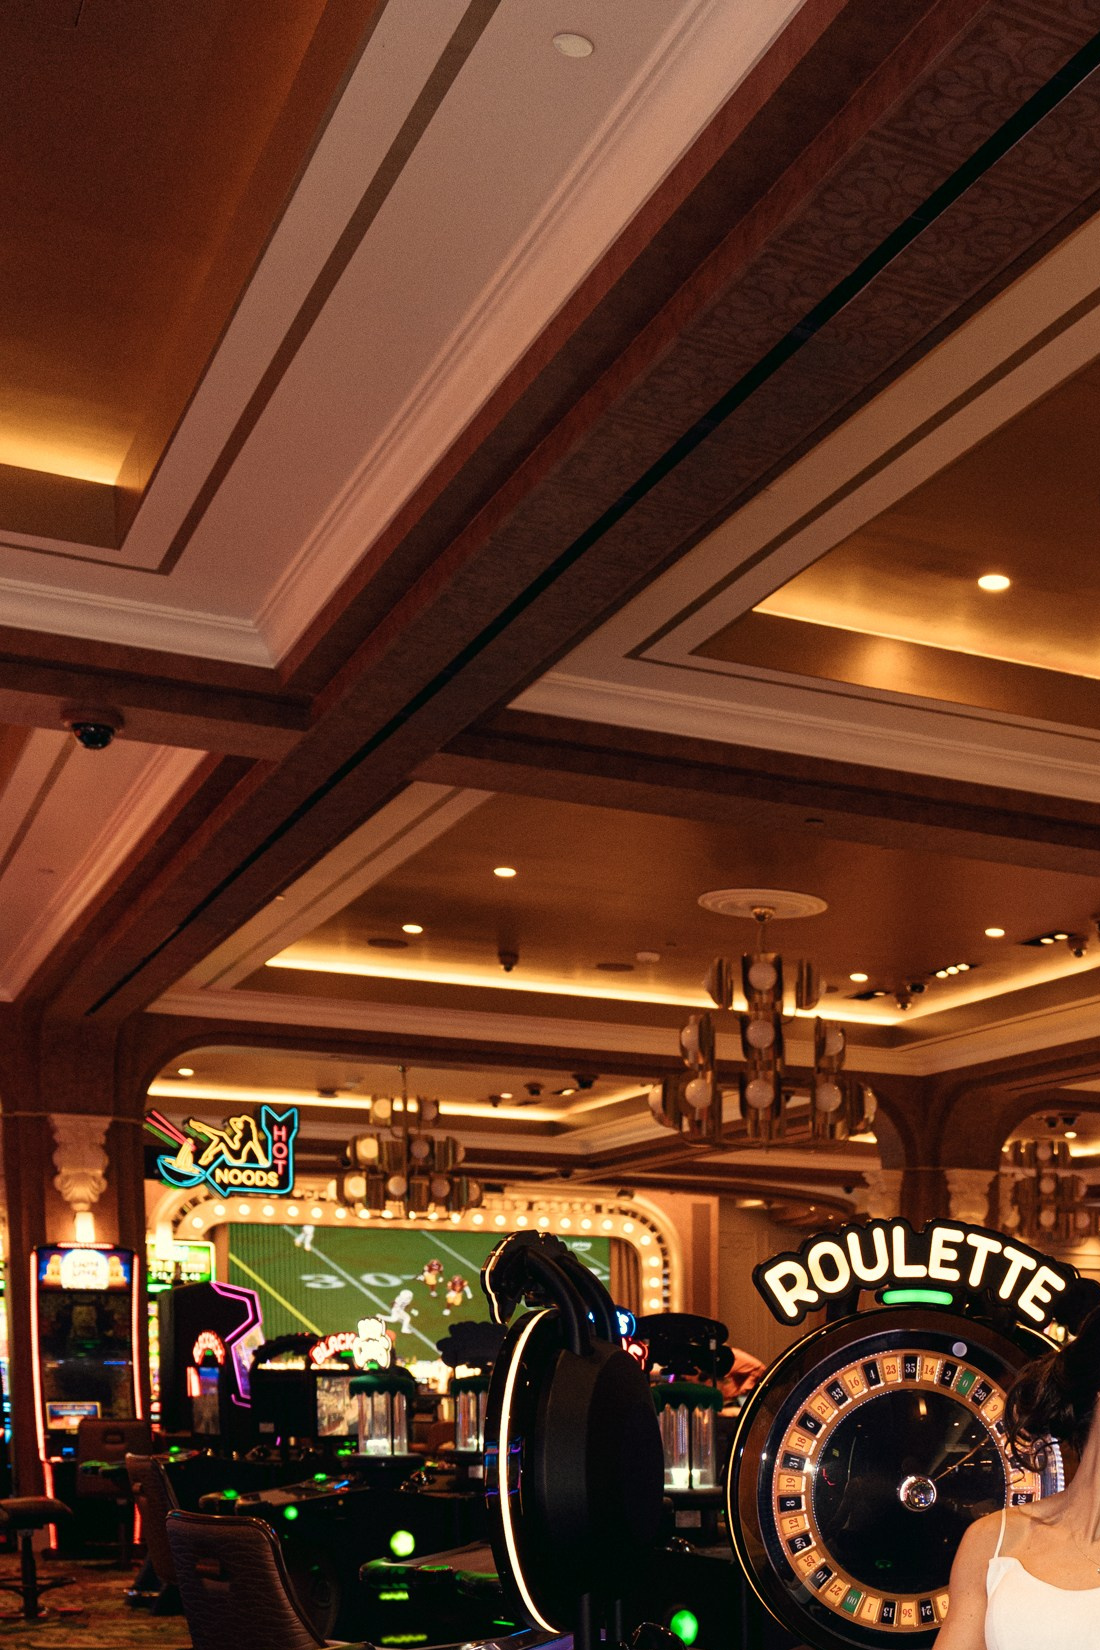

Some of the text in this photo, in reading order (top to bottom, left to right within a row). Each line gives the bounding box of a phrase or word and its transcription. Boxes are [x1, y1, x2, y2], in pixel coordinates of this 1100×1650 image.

[273, 1125, 287, 1175] HOT
[215, 1168, 279, 1187] NOODS
[764, 1225, 1066, 1322] ROULETTE
[886, 1364, 896, 1375] 23
[905, 1363, 916, 1374] 35
[924, 1365, 934, 1375] 14
[870, 1370, 876, 1380] 4
[945, 1371, 951, 1380] 2
[849, 1377, 859, 1389] 16
[832, 1388, 843, 1400] 33
[975, 1388, 987, 1401] 28
[818, 1403, 829, 1414] 21
[795, 1437, 807, 1449] 18
[789, 1457, 800, 1468] 31
[786, 1478, 796, 1488] 19
[1017, 1494, 1026, 1505] 20
[789, 1518, 799, 1529] 12
[794, 1537, 806, 1549] 29
[803, 1554, 815, 1567] 25
[815, 1570, 828, 1582] 10
[829, 1584, 843, 1596] 27
[846, 1595, 858, 1606] 00
[942, 1600, 948, 1609] 3
[867, 1603, 873, 1612] 1
[883, 1607, 894, 1617] 13
[902, 1608, 913, 1618] 36
[921, 1606, 932, 1616] 24
